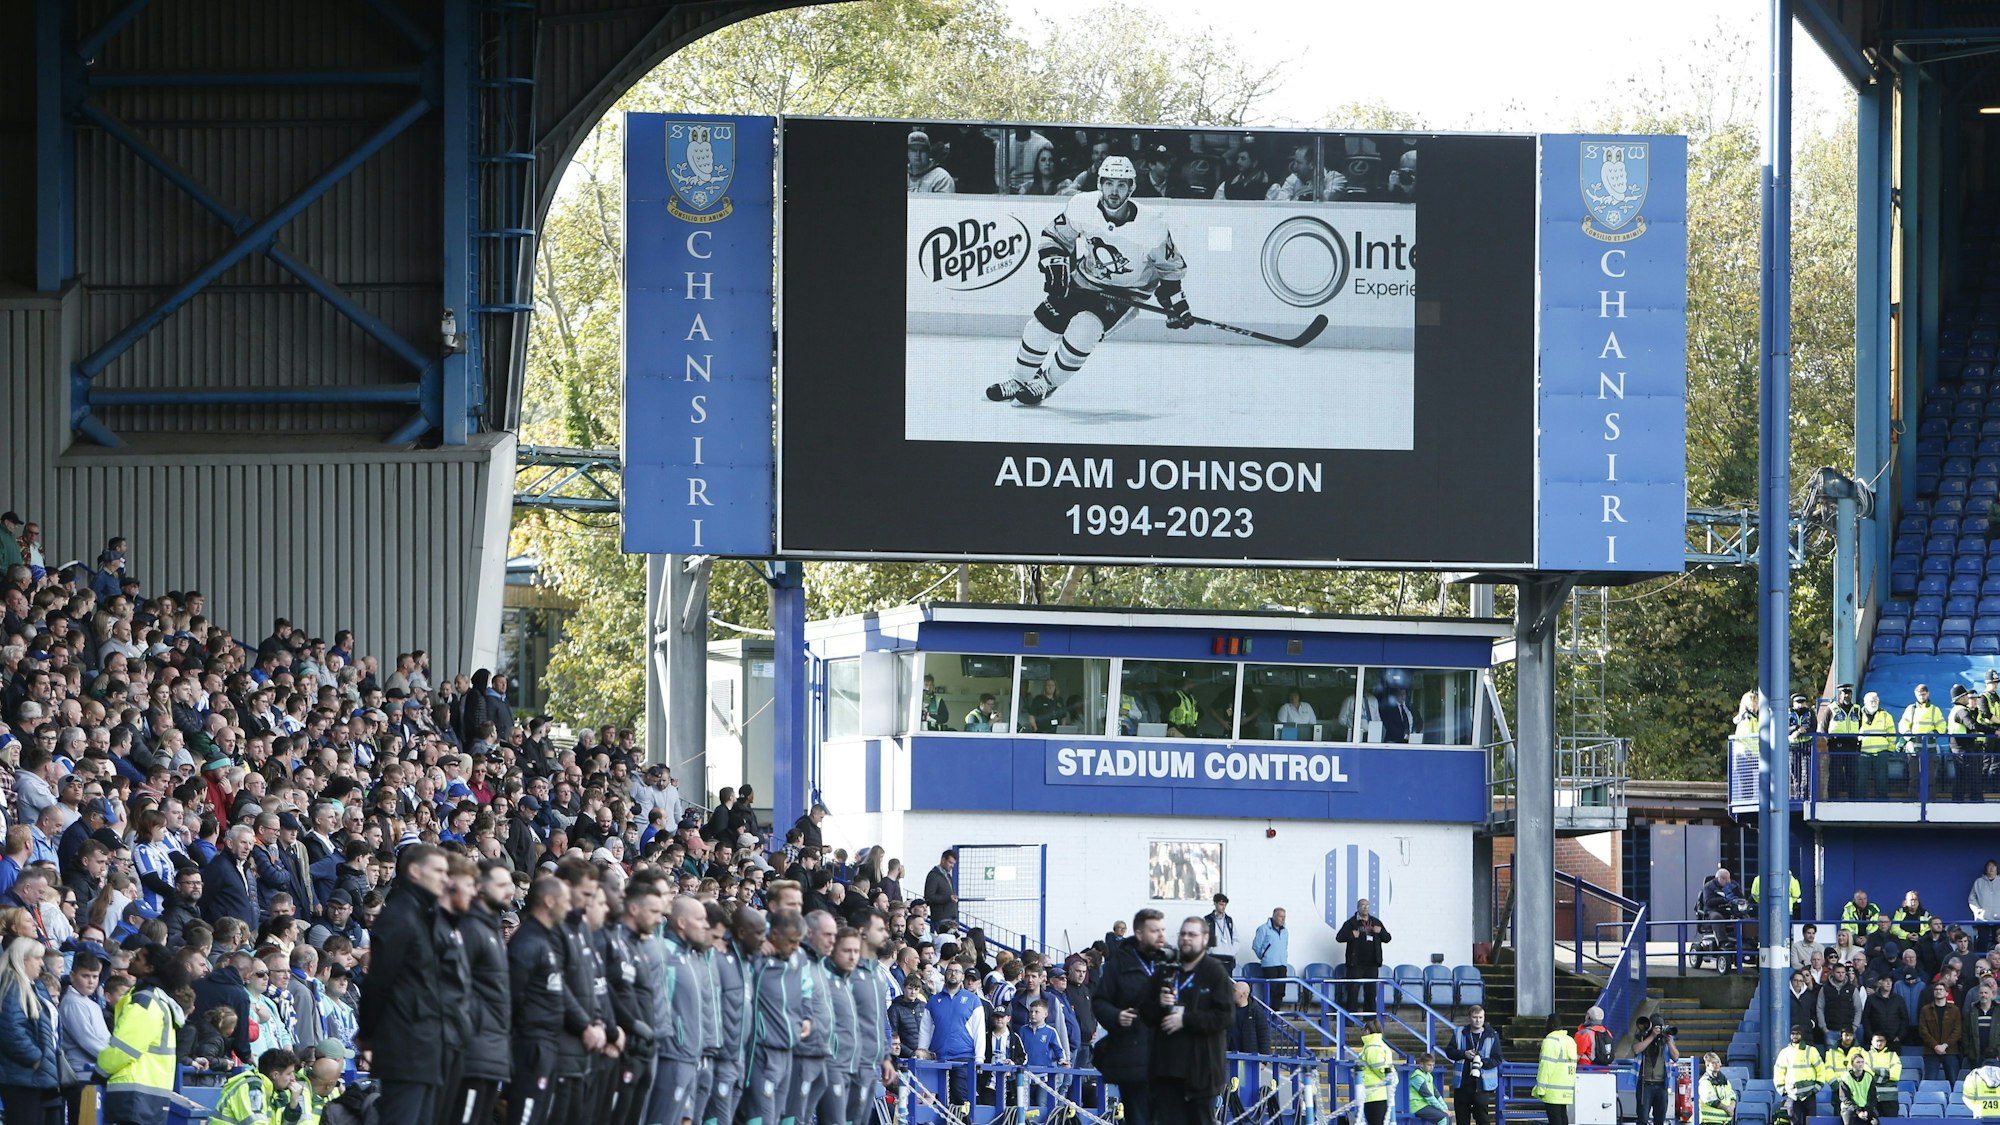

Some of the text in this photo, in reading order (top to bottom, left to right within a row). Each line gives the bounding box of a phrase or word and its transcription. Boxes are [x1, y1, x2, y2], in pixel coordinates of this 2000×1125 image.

[670, 207, 730, 223] CONSILIO ET ANIMIS
[958, 218, 997, 252] Dr
[1355, 231, 1417, 271] Int
[1585, 227, 1643, 242] CONSILIO ET ANIMIS
[918, 226, 1022, 283] Pepper
[684, 230, 715, 548] CHANSIRI
[1598, 250, 1629, 564] CHANSIRI
[994, 456, 1323, 493] ADAM JOHNSON
[1065, 504, 1255, 539] 1994-2023
[1057, 747, 1348, 783] STADIUM CONTROL
[1982, 1100, 1999, 1110] 249
